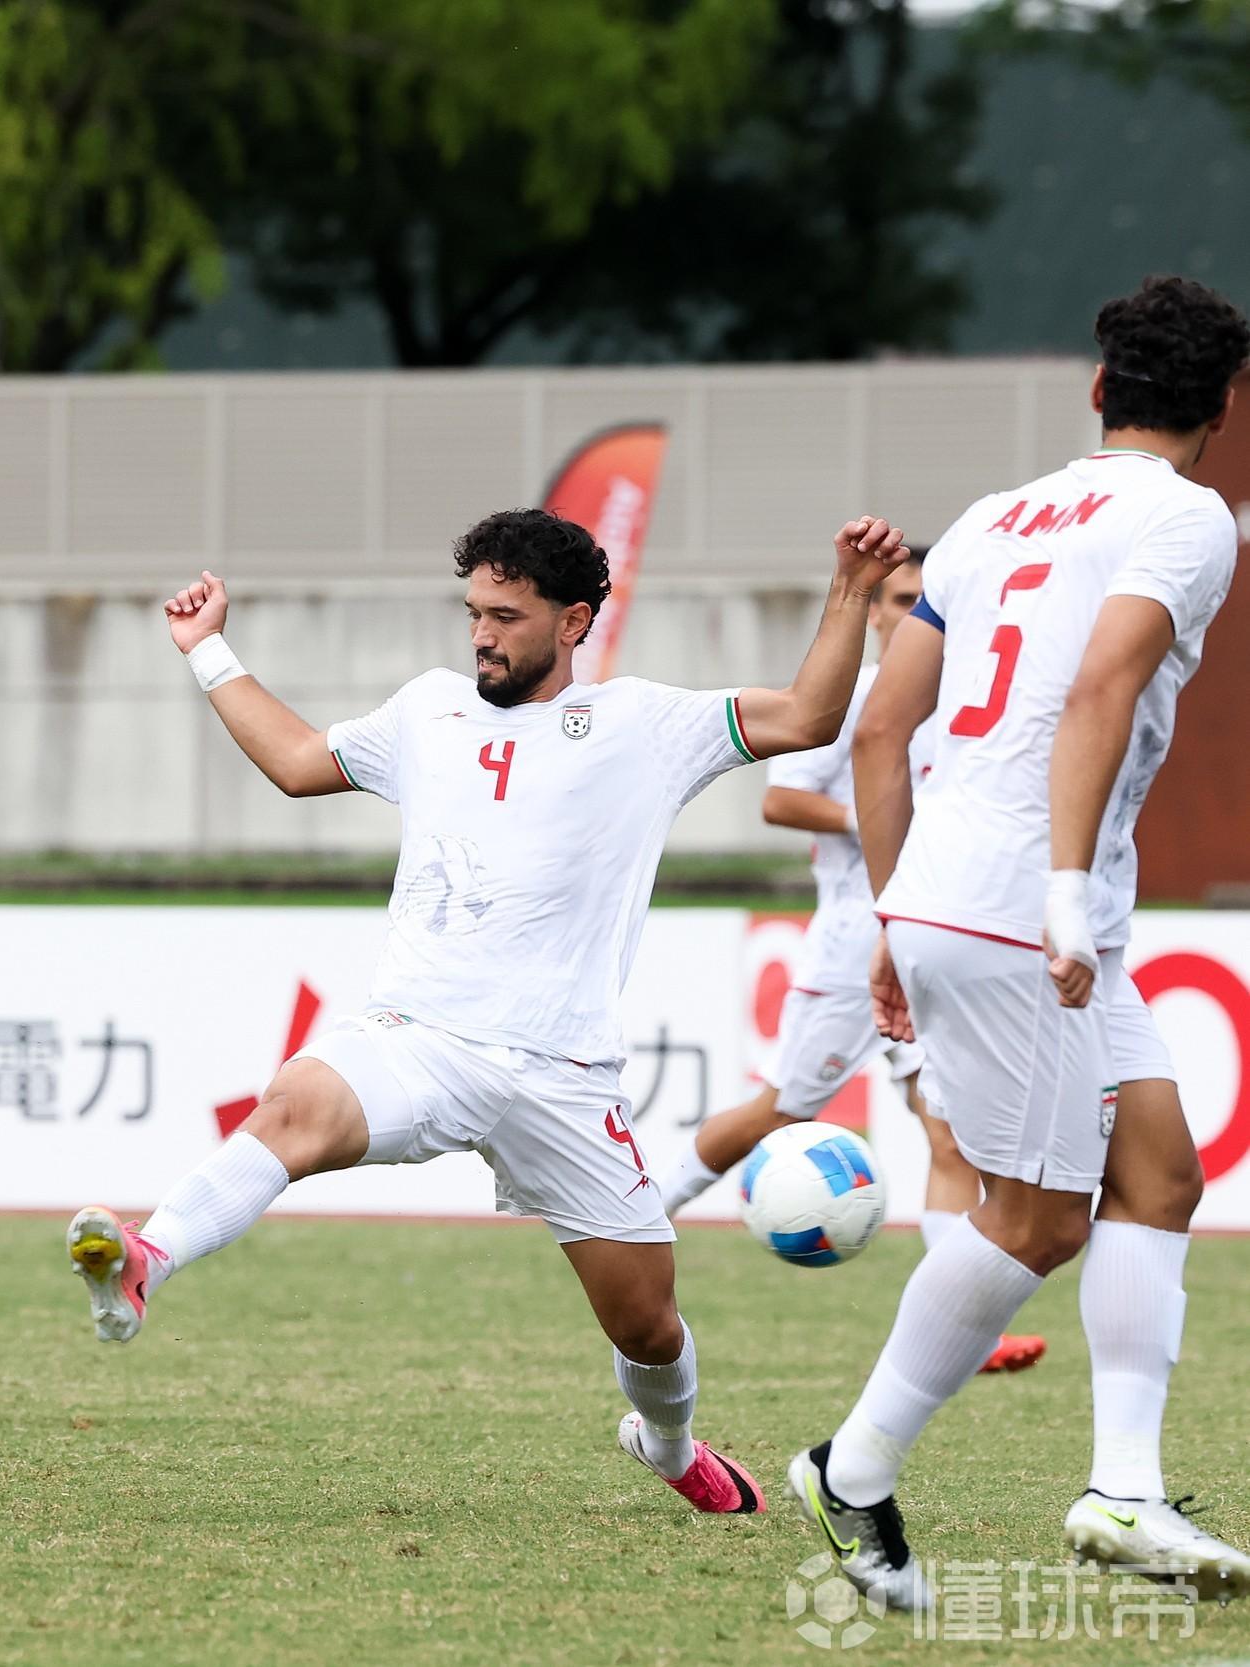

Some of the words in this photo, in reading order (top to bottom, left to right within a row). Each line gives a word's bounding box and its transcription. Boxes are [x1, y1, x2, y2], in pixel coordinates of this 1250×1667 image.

[949, 562, 1052, 738] 5
[478, 740, 516, 801] 4
[604, 1104, 644, 1172] 4
